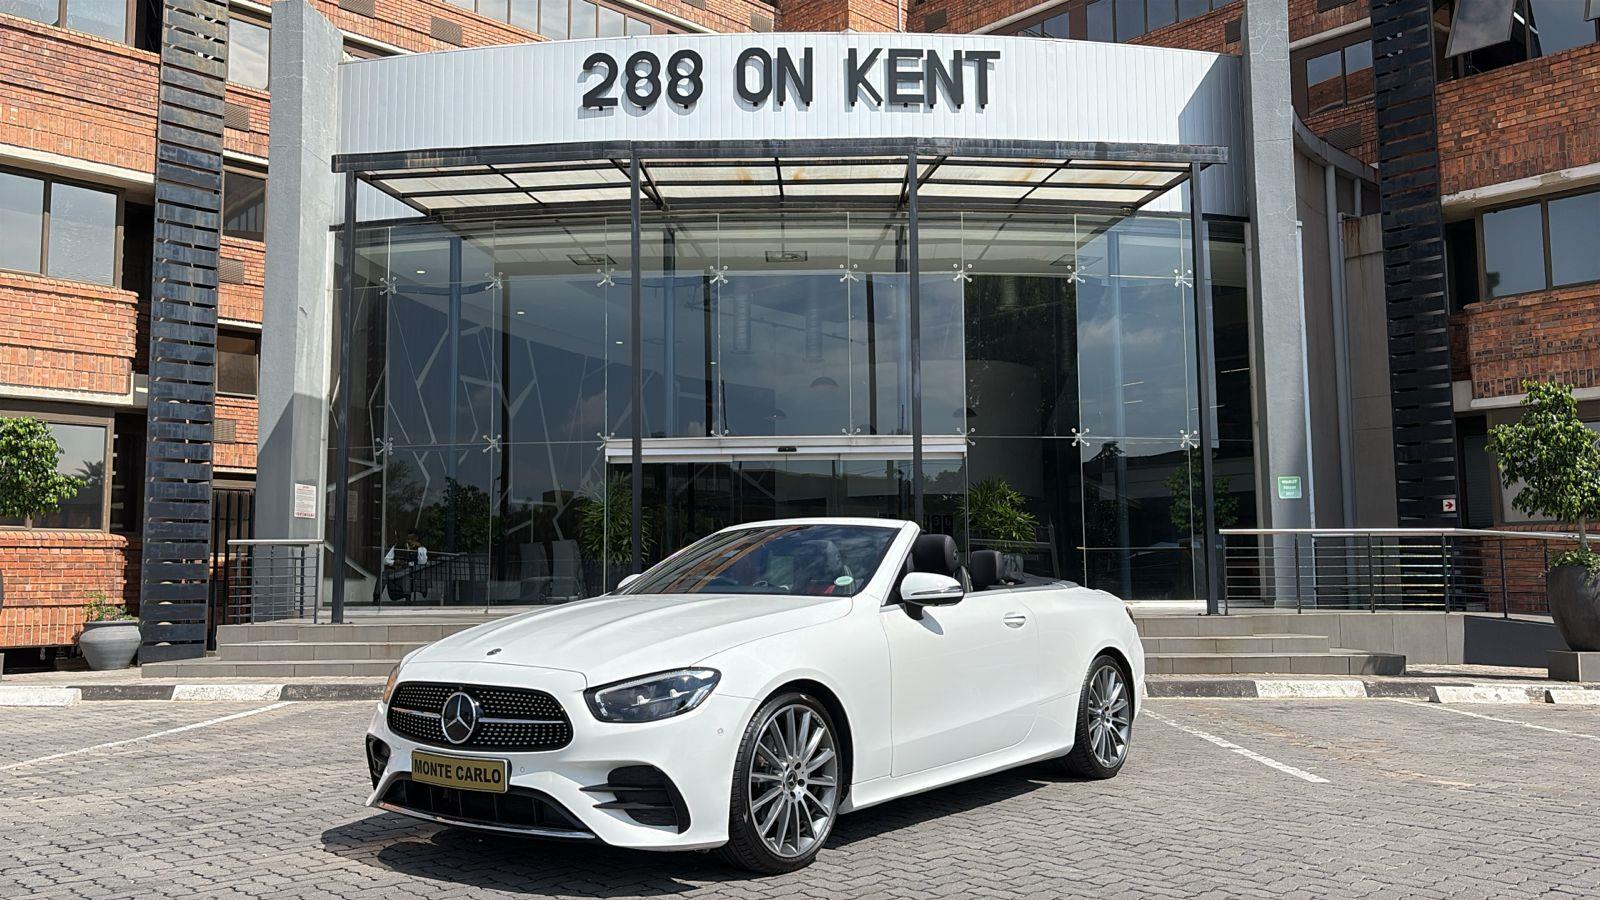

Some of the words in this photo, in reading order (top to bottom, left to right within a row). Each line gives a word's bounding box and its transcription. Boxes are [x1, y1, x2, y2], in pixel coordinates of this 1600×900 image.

[582, 49, 703, 107] 288
[736, 47, 813, 102] ON
[848, 48, 1001, 105] KENT
[414, 759, 452, 779] MONTE
[455, 765, 501, 784] CARLO
